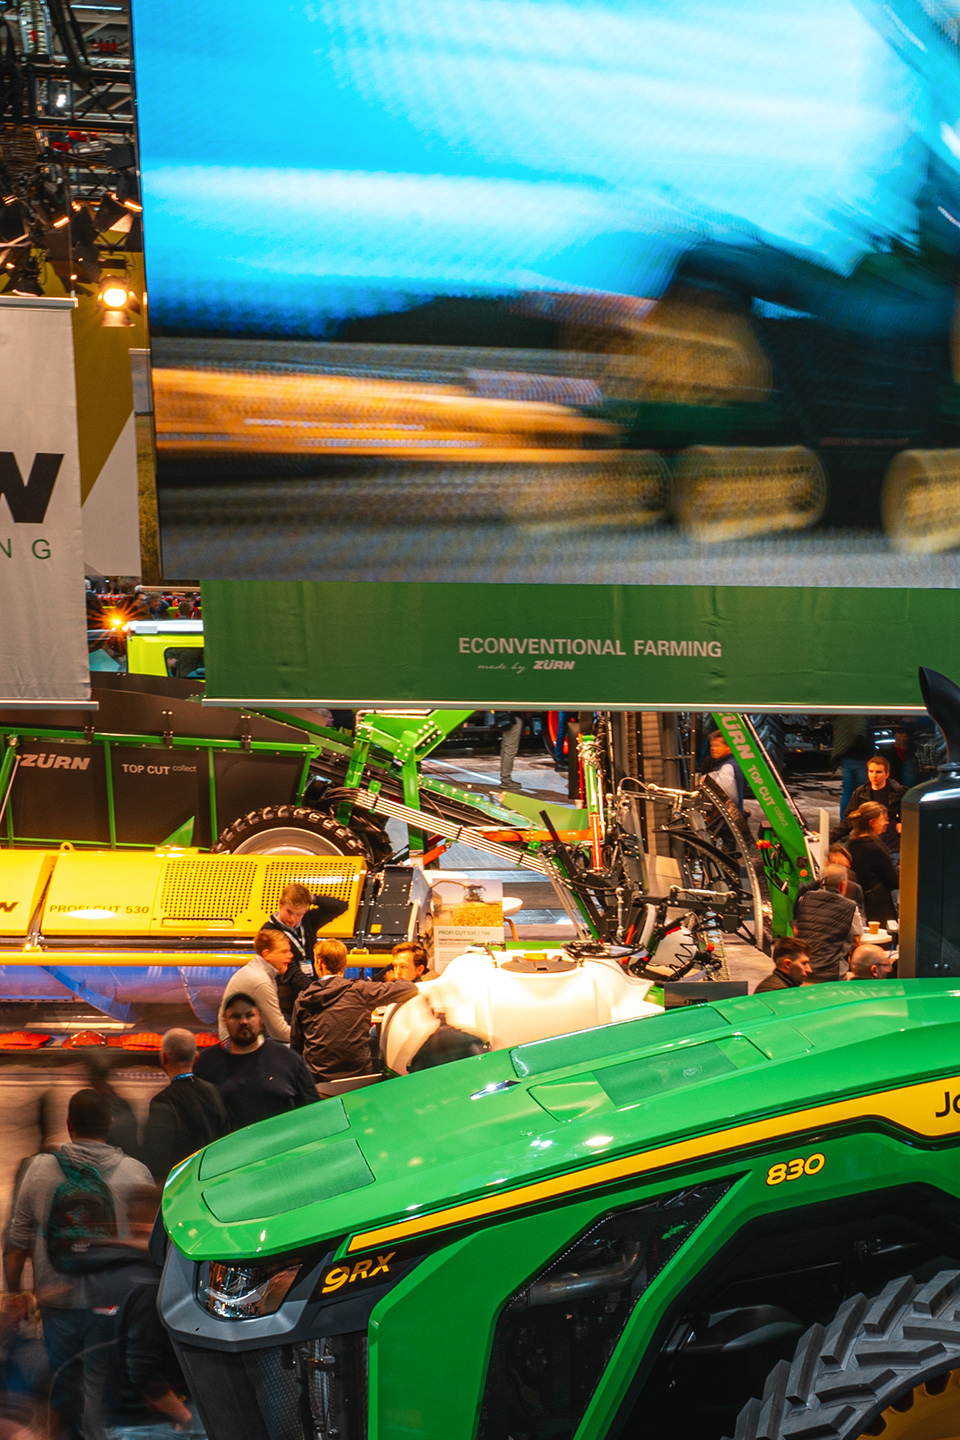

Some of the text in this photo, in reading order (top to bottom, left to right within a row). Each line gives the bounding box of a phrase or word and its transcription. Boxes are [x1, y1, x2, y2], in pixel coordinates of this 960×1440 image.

[458, 637, 722, 658] ECONVENTIONAL FARMING
[477, 659, 576, 675] made by ZÜRN
[20, 752, 91, 771] ZÜRN
[121, 763, 197, 776] TOP CUT collect
[747, 764, 764, 785] TOP
[758, 786, 776, 807] CUT
[125, 905, 150, 915] 530
[765, 1151, 826, 1187] 830
[321, 1251, 397, 1294] 9RX
